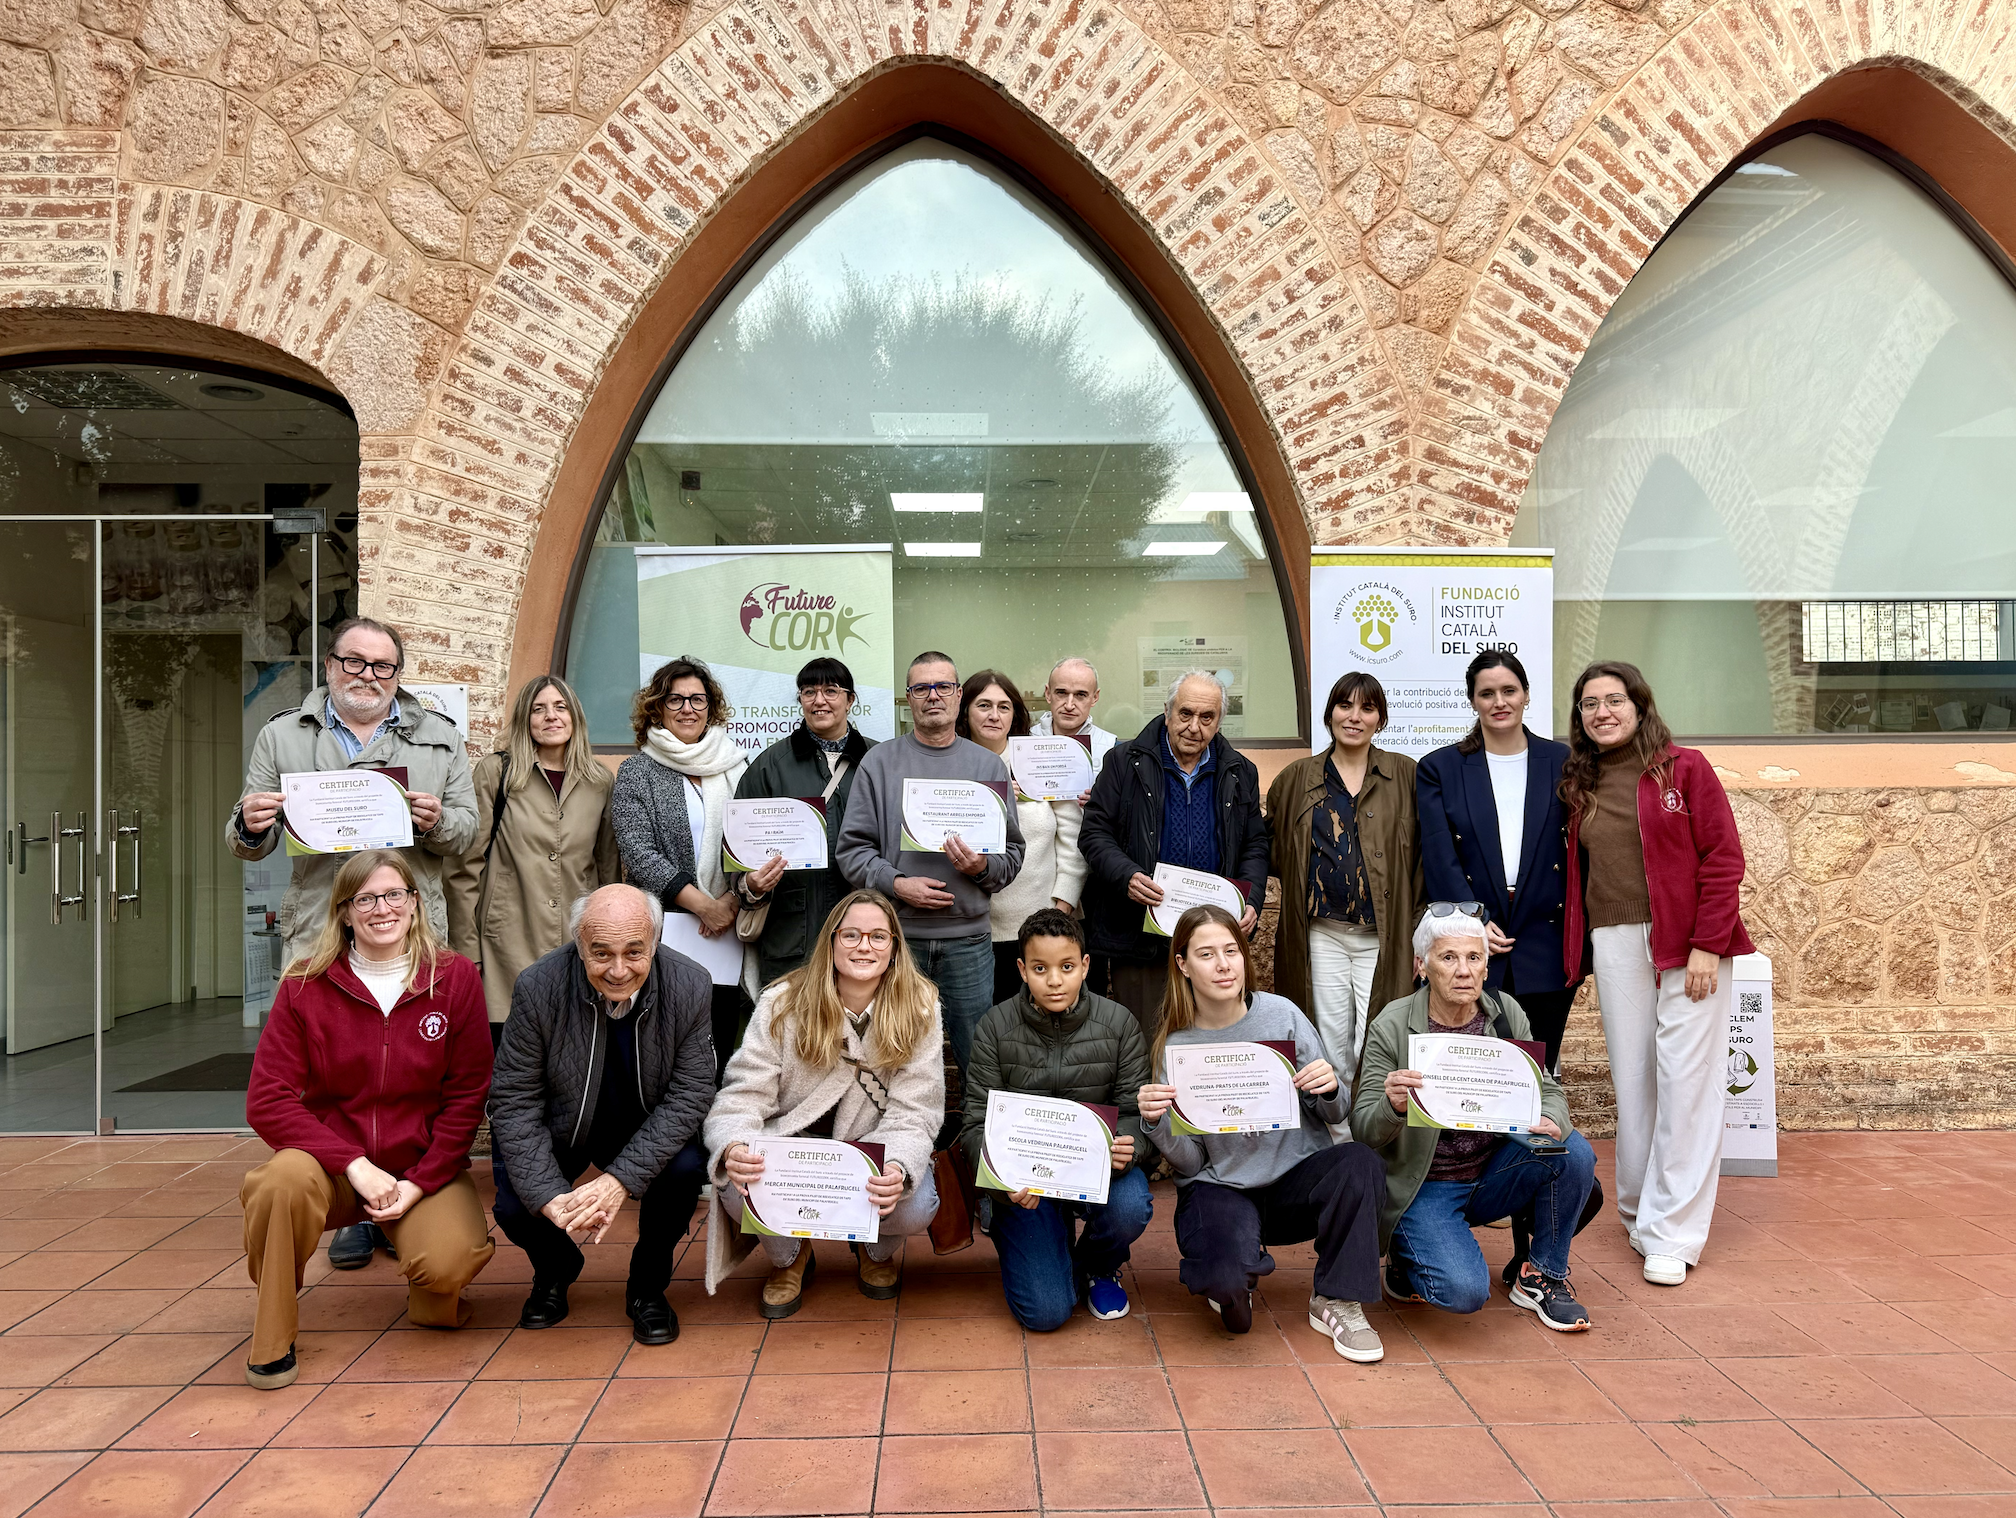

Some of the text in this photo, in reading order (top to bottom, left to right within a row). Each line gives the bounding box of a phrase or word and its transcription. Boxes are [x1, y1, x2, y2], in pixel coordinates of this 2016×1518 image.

[1441, 584, 1520, 601] FUNDACIÓ
[765, 585, 836, 614] Future
[1334, 582, 1417, 621] INSTITUT CATALÀ DEL SURO
[1441, 605, 1504, 619] INSTITUT
[1441, 620, 1497, 637] CATALÀ
[1441, 642, 1518, 655] DEL SURO
[1349, 648, 1404, 665] www.icsuro.com
[1393, 687, 1401, 696] la
[1403, 687, 1451, 697] contribució
[1454, 687, 1467, 696] del
[1387, 700, 1423, 709] evolució
[1425, 700, 1458, 710] positiva
[1408, 724, 1469, 734] l'aprofitament
[1034, 743, 1067, 751] CERTIFICAT
[1411, 737, 1429, 746] dels
[319, 779, 370, 790] CERTIFICAT
[934, 789, 975, 797] CERTIFICAT
[753, 807, 794, 815] CERTIFICAT
[1182, 878, 1221, 891] CERTIFICAT
[1448, 1046, 1502, 1058] CERTIFICAT
[1204, 1053, 1256, 1064] CERTIFICAT
[1494, 1080, 1530, 1088] PALAFRUGELL
[1024, 1107, 1078, 1122] CERTIFICAT
[1027, 1139, 1053, 1148] VEDRUNA
[1053, 1143, 1088, 1153] PALAFRUGELL
[788, 1150, 843, 1162] CERTIFICAT
[825, 1184, 860, 1192] PALAFRUGELL
